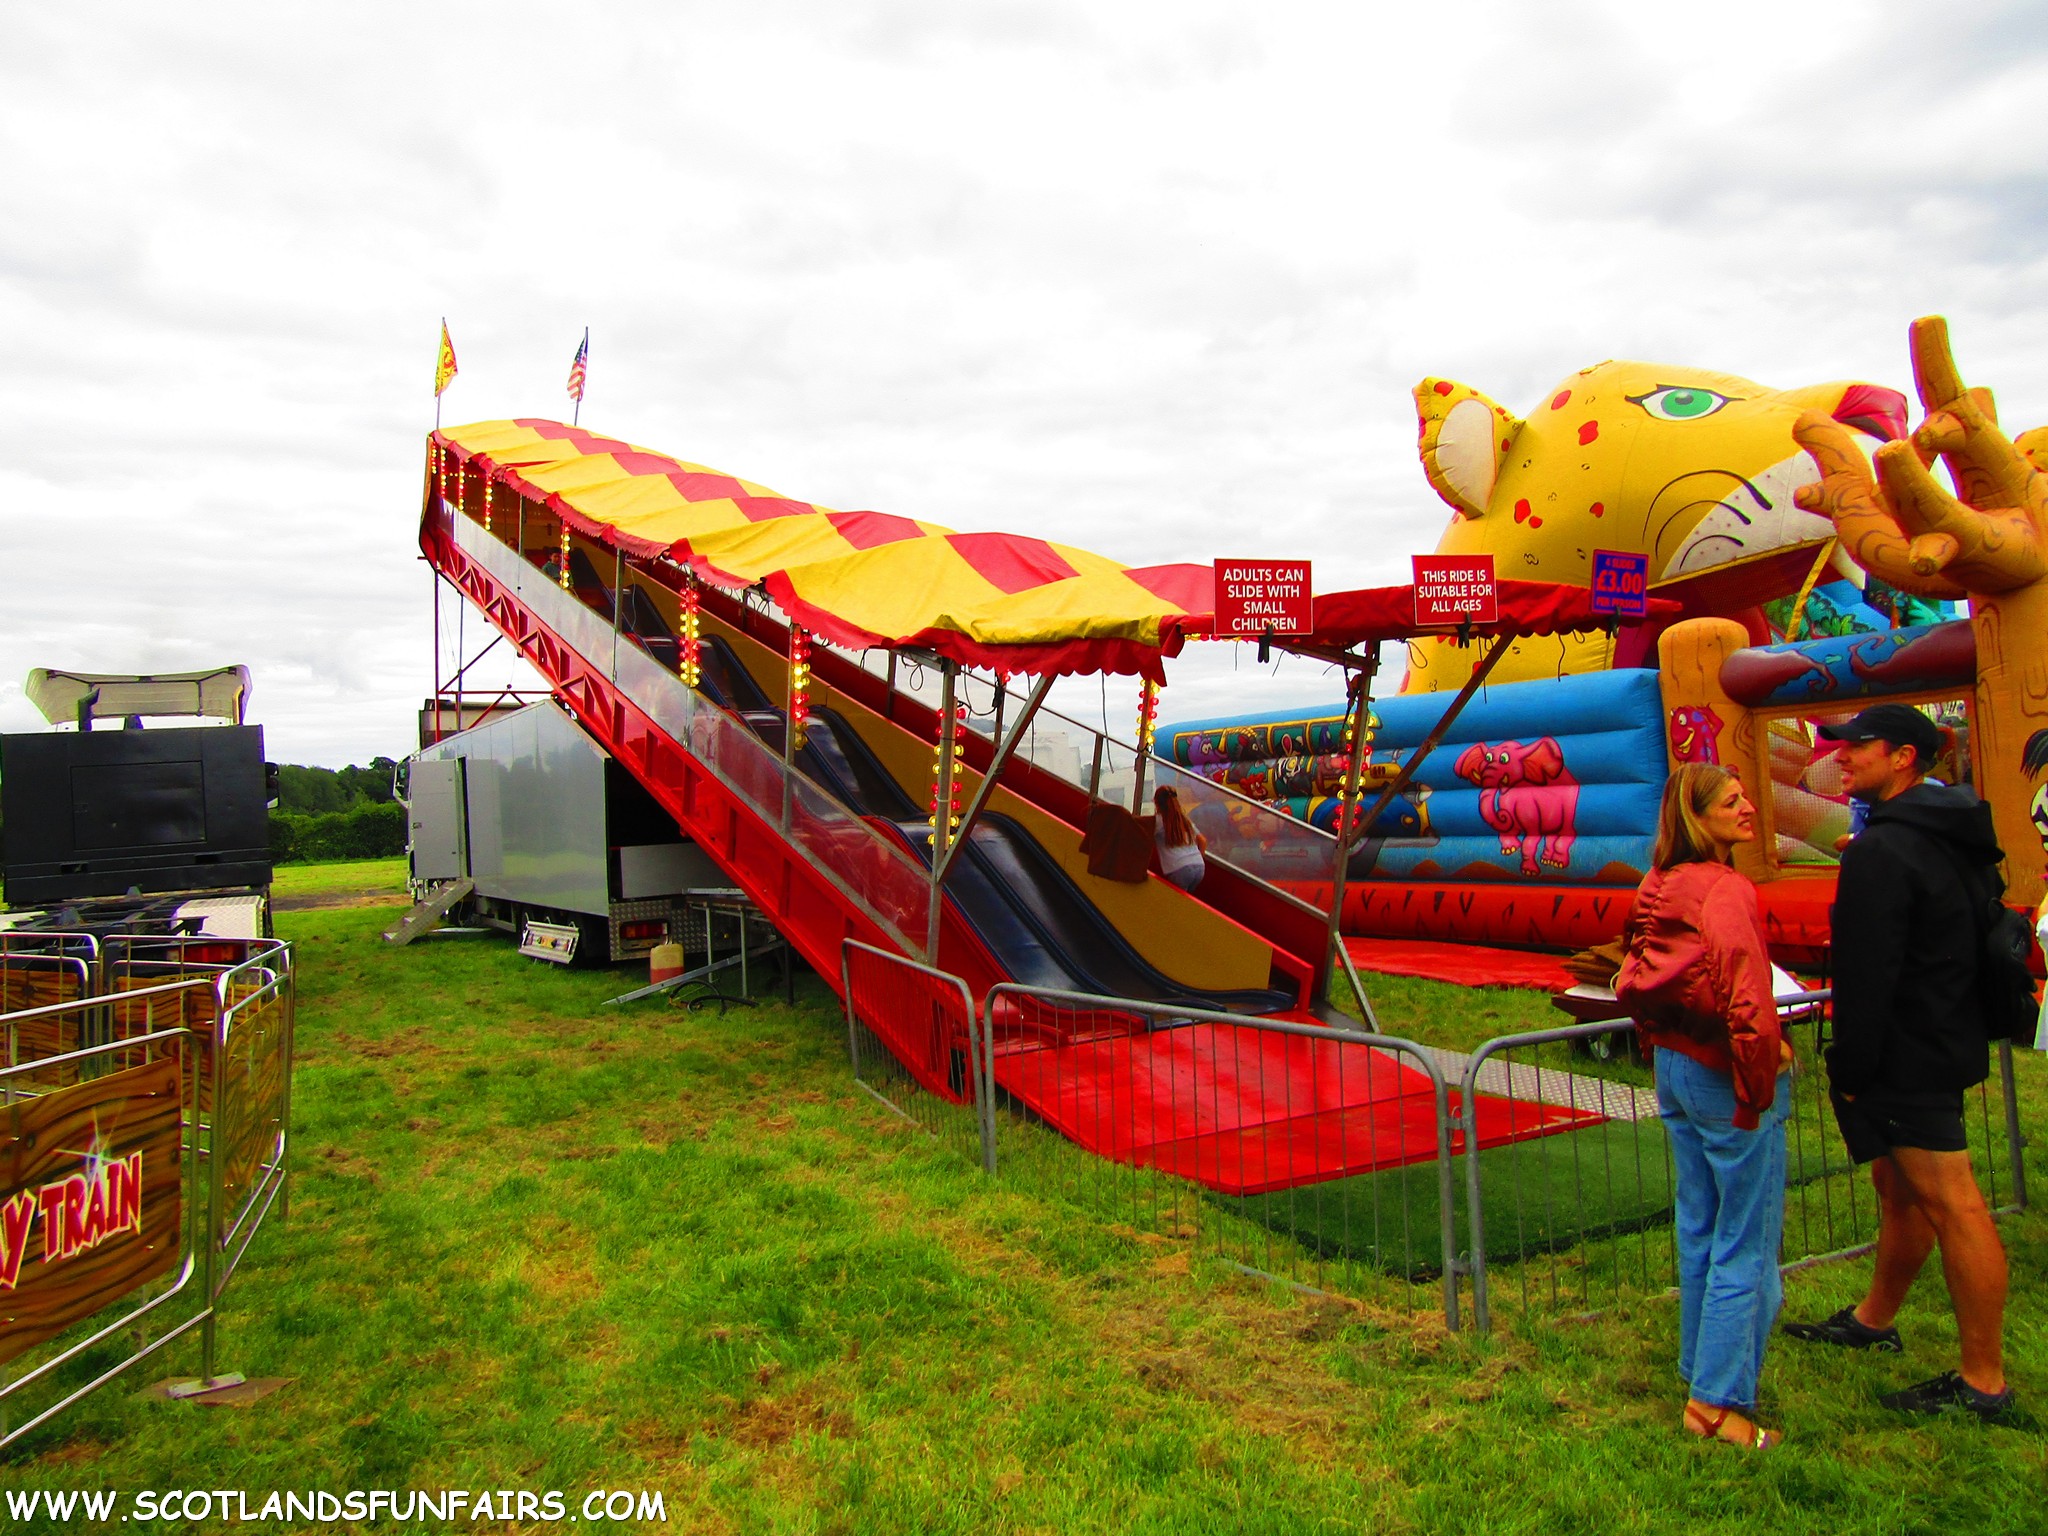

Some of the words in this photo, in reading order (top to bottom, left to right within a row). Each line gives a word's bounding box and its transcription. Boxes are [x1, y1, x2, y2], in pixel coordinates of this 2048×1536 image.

[1223, 568, 1272, 582] ADULTS
[1275, 568, 1304, 582] CAN
[1422, 570, 1447, 583] THIS
[1449, 569, 1474, 583] RIDE
[1476, 569, 1486, 582] IS
[1597, 570, 1642, 594] £3.00
[1227, 585, 1264, 598] SLIDE
[1267, 585, 1300, 598] WITH
[1418, 585, 1468, 598] SUITABLE
[1470, 584, 1493, 597] FOR
[1243, 601, 1286, 615] SMALL
[1431, 600, 1451, 613] ALL
[1453, 599, 1482, 612] AGES
[1232, 617, 1297, 631] CHILDREN
[38, 1150, 143, 1263] TRAIN
